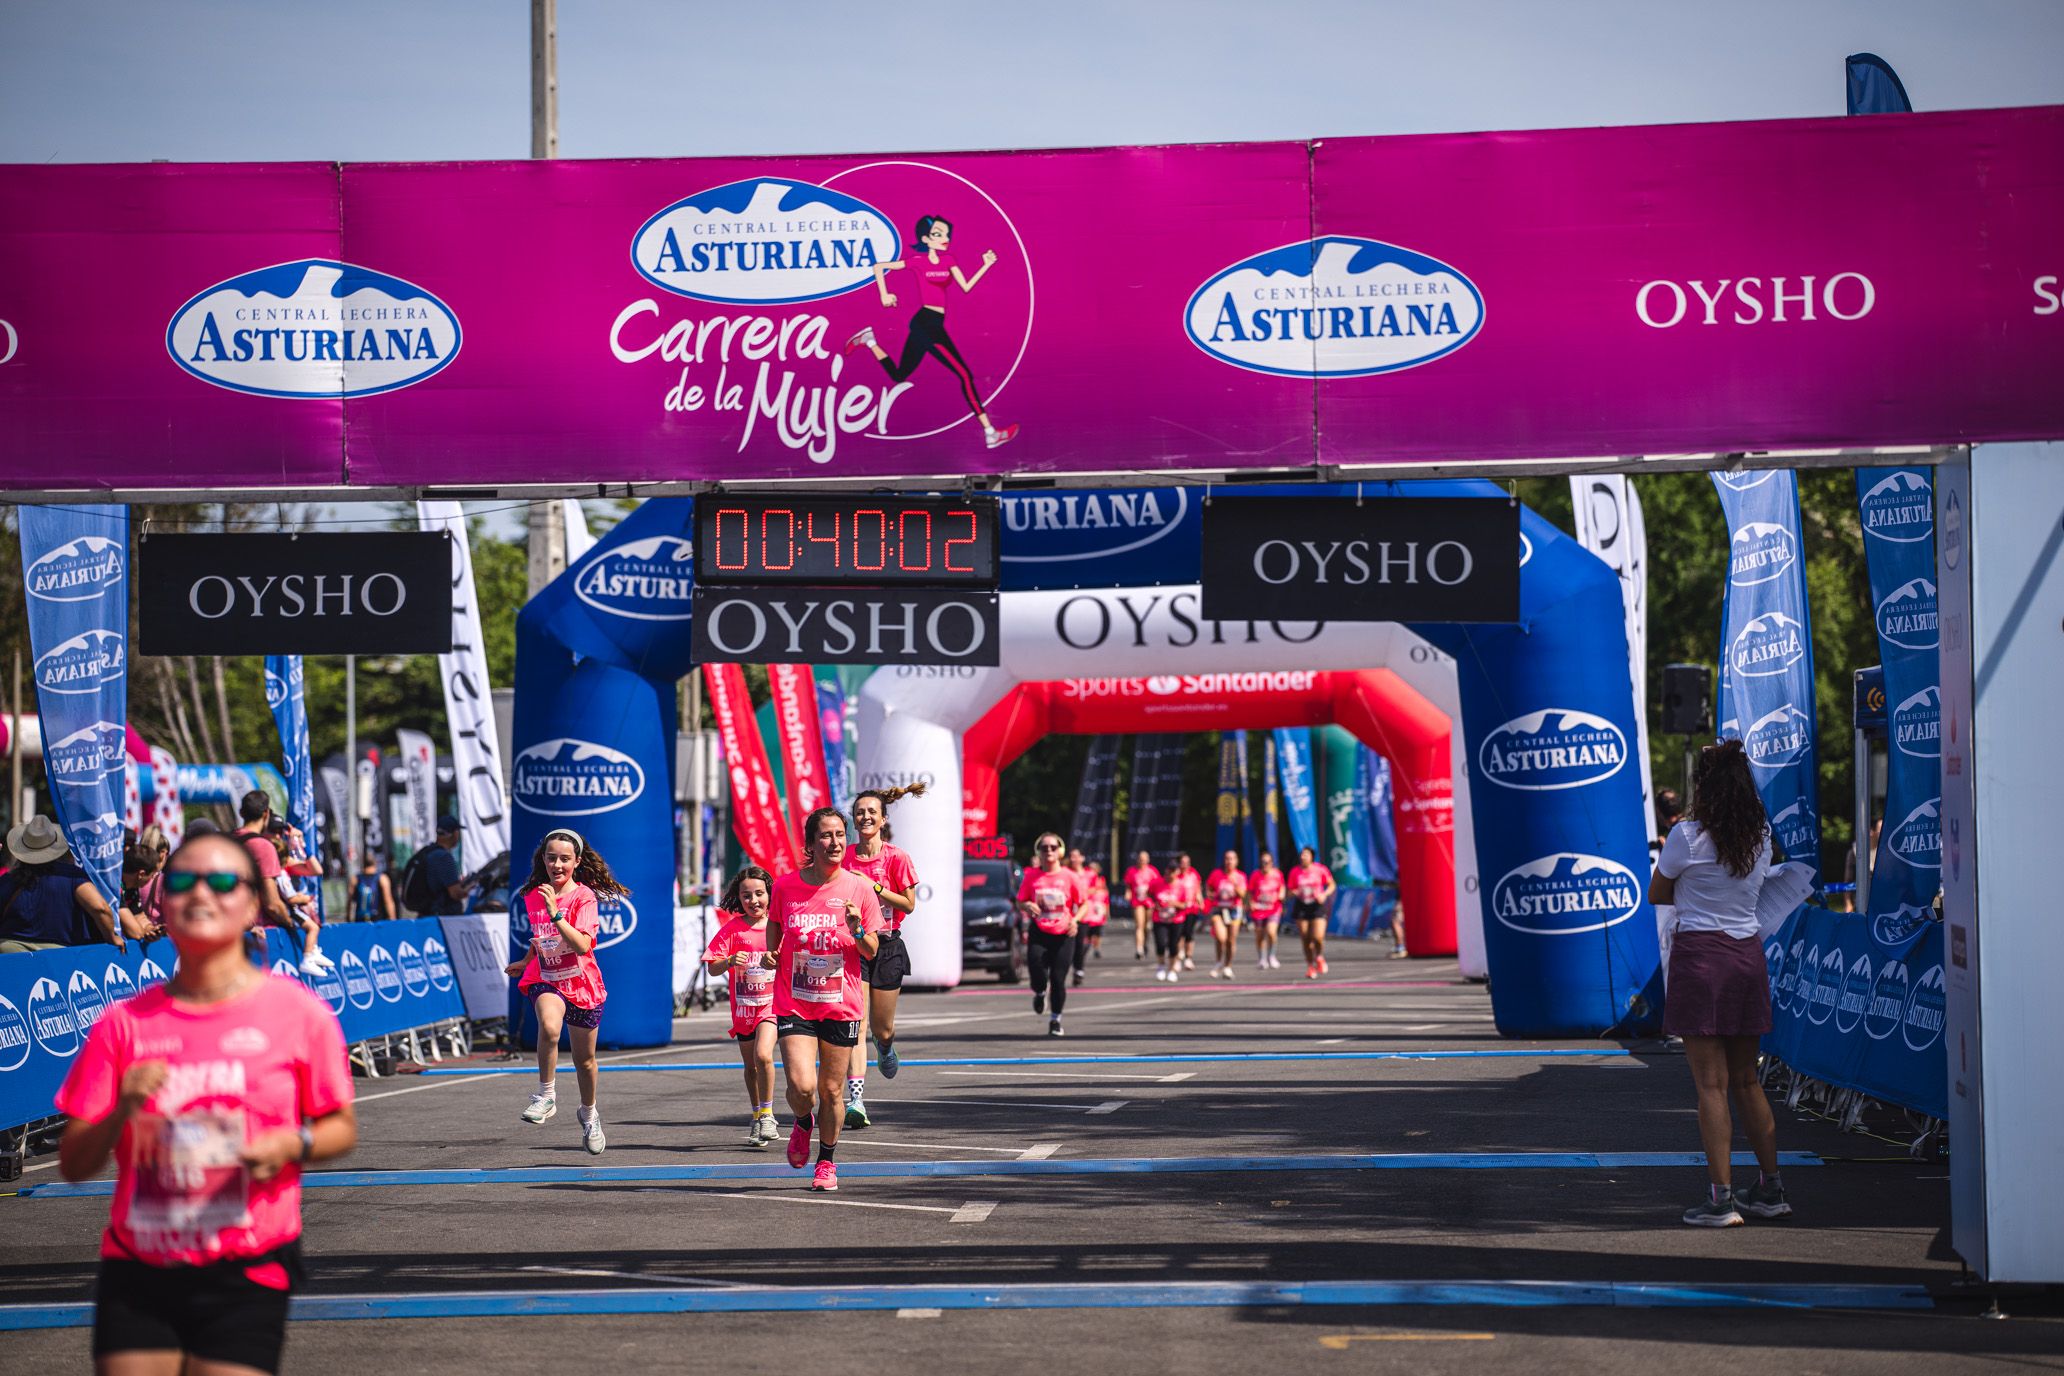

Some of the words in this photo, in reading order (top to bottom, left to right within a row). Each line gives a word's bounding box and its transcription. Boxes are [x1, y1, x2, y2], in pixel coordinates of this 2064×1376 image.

[694, 222, 777, 236] CENTRAL
[785, 219, 872, 234] LECHERA
[652, 226, 878, 274] ASTURIANA
[1254, 286, 1346, 301] CENTRAL
[1355, 282, 1452, 298] LECHERA
[1635, 271, 1876, 329] OYSHO
[235, 308, 330, 321] CENTRAL
[1208, 291, 1461, 342] ASTURIANA
[190, 312, 439, 363] ASTURIANA
[609, 298, 830, 364] Carrera
[664, 366, 706, 412] de
[714, 364, 744, 412] la
[737, 355, 914, 464] Mujer
[1000, 491, 1166, 532] URIANA
[715, 508, 977, 572] 00:40:02
[614, 562, 672, 575] CENTRAL
[1252, 538, 1474, 586] OYSHO
[187, 571, 408, 620] OYSHO
[583, 563, 693, 600] ASTURI
[706, 598, 987, 658] OYSHO
[1183, 670, 1318, 695] Santander
[1506, 736, 1560, 748] CENTRAL
[1564, 732, 1615, 744] LECHERA
[576, 764, 630, 774] LECHERA
[1488, 743, 1621, 774] ASTURIANA
[514, 764, 634, 796] ASTURIANA
[1519, 879, 1573, 892] CENTRAL
[1578, 876, 1628, 889] LECHERA
[1501, 886, 1634, 917] ASTURIANA
[788, 913, 838, 929] CARRERA
[747, 983, 766, 991] 016
[808, 975, 827, 986] 016
